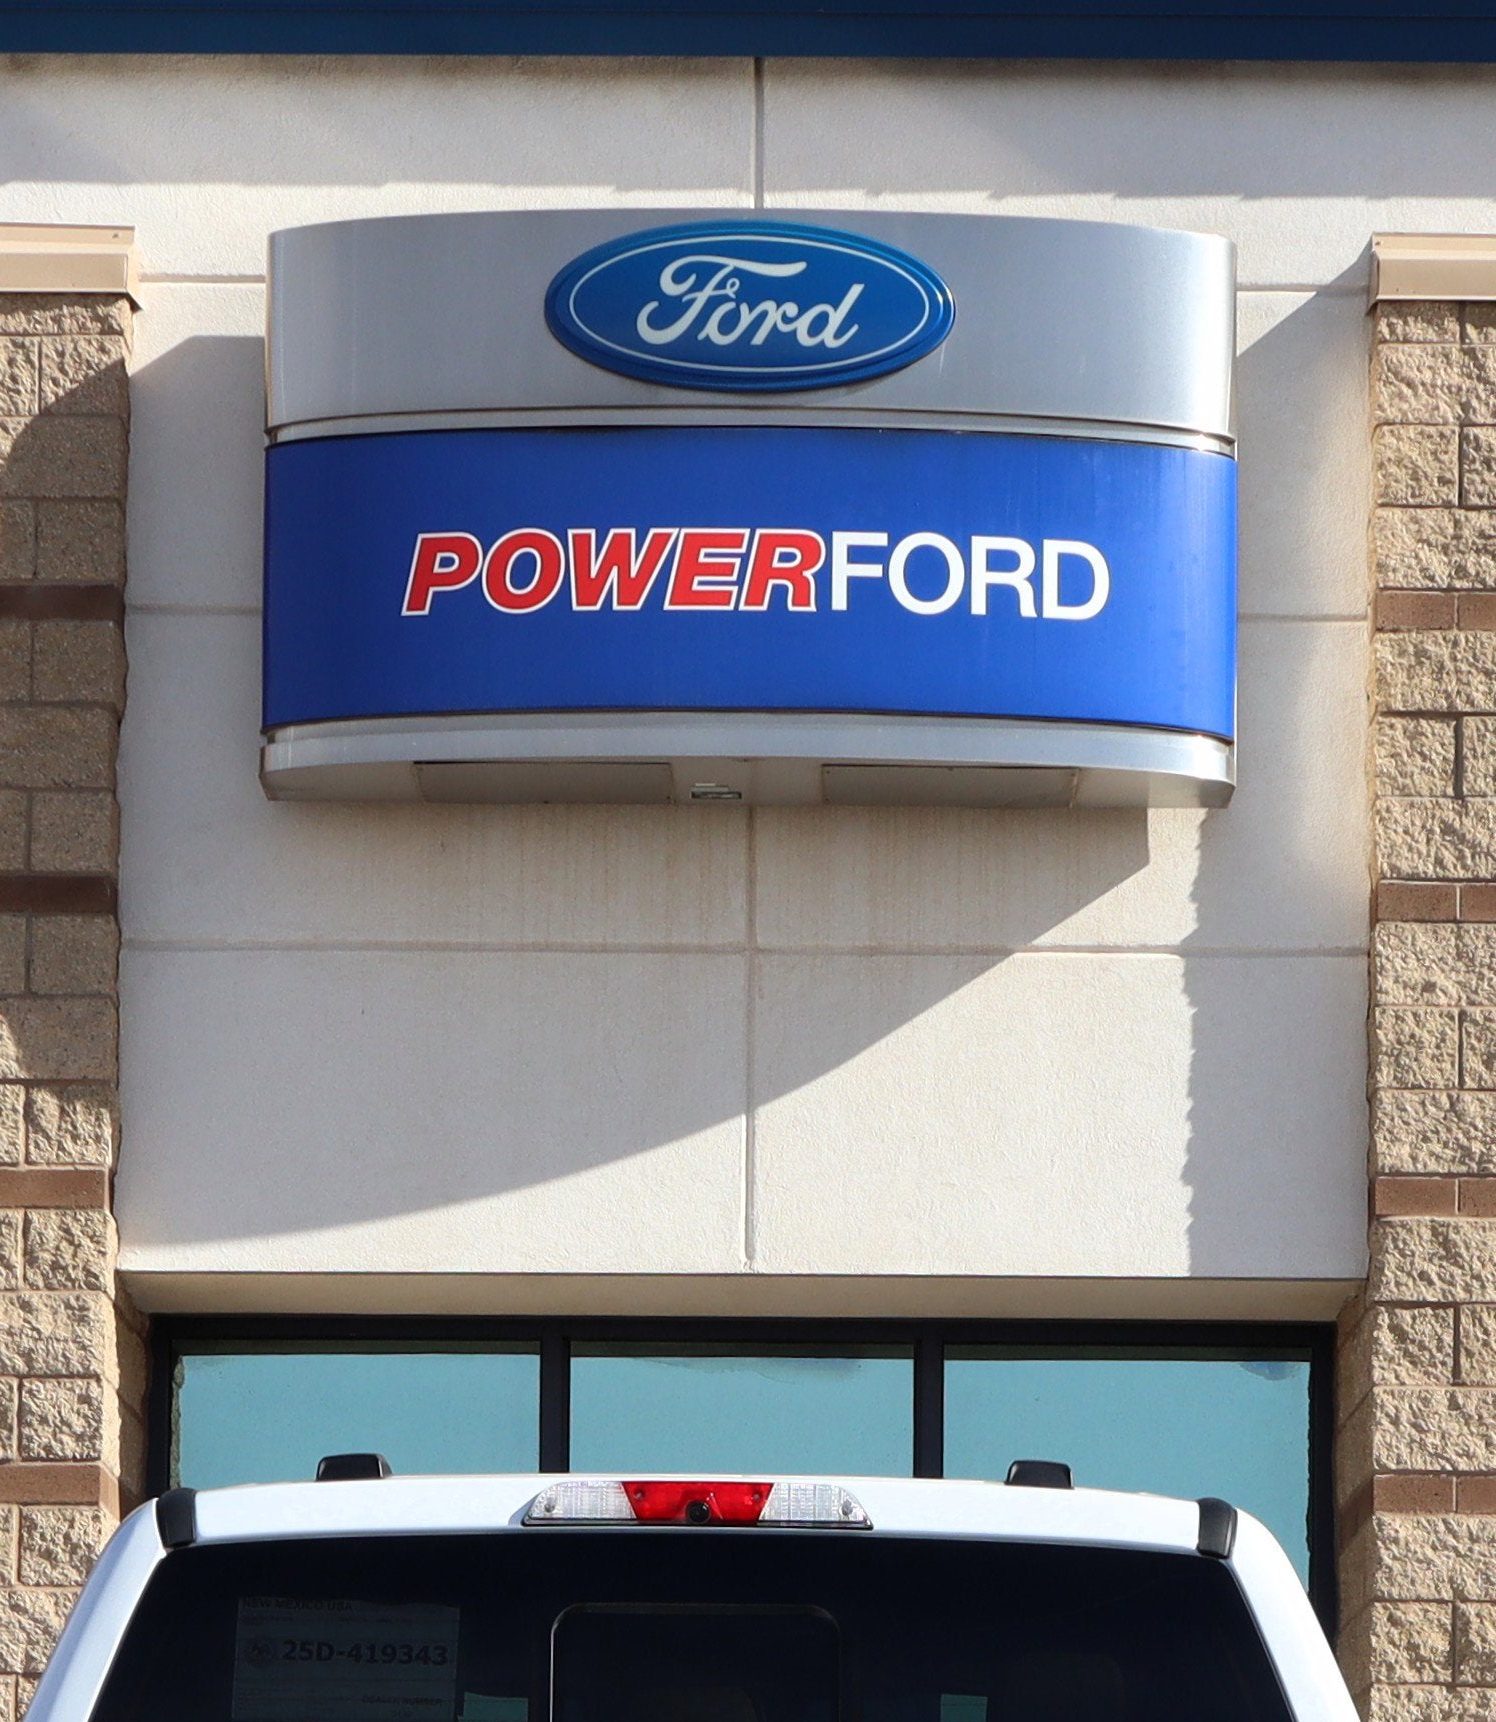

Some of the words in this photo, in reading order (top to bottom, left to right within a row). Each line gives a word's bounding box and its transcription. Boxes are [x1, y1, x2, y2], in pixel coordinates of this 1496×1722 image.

[636, 254, 865, 349] Ford
[400, 528, 1111, 622] POWERFORD
[281, 1639, 448, 1666] 25D-419343
